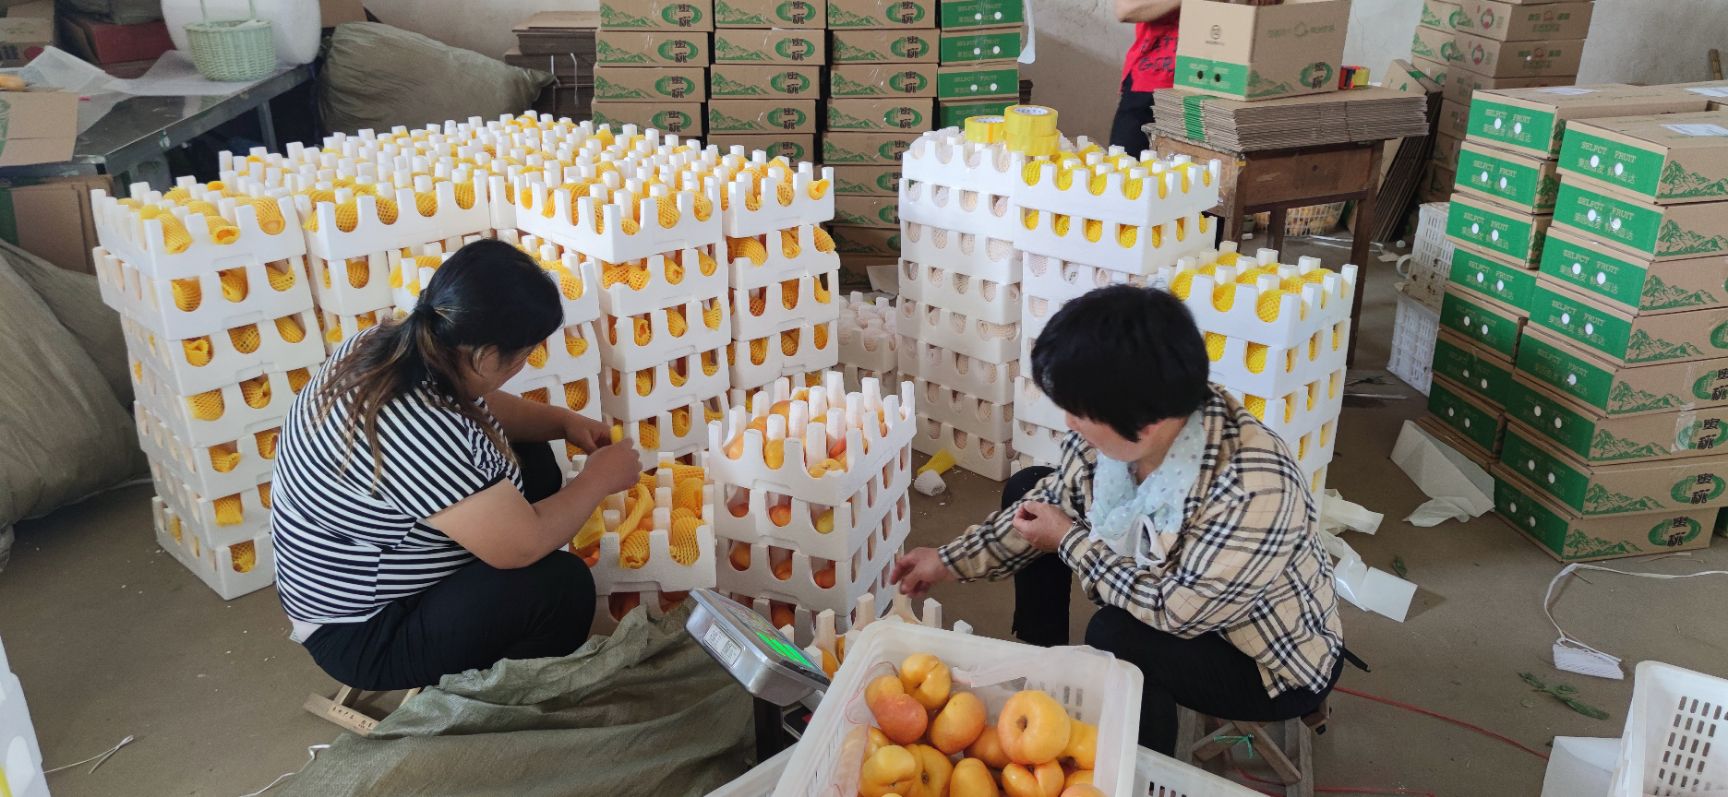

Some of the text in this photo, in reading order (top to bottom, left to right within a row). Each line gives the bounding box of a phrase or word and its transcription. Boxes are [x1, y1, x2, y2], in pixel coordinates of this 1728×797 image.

[1580, 142, 1637, 164] SELECT FRUIT
[1578, 197, 1634, 220] SELECT FRUIT
[1564, 250, 1619, 274] SELECT FRUIT
[1552, 301, 1605, 326] SELECT FRUIT
